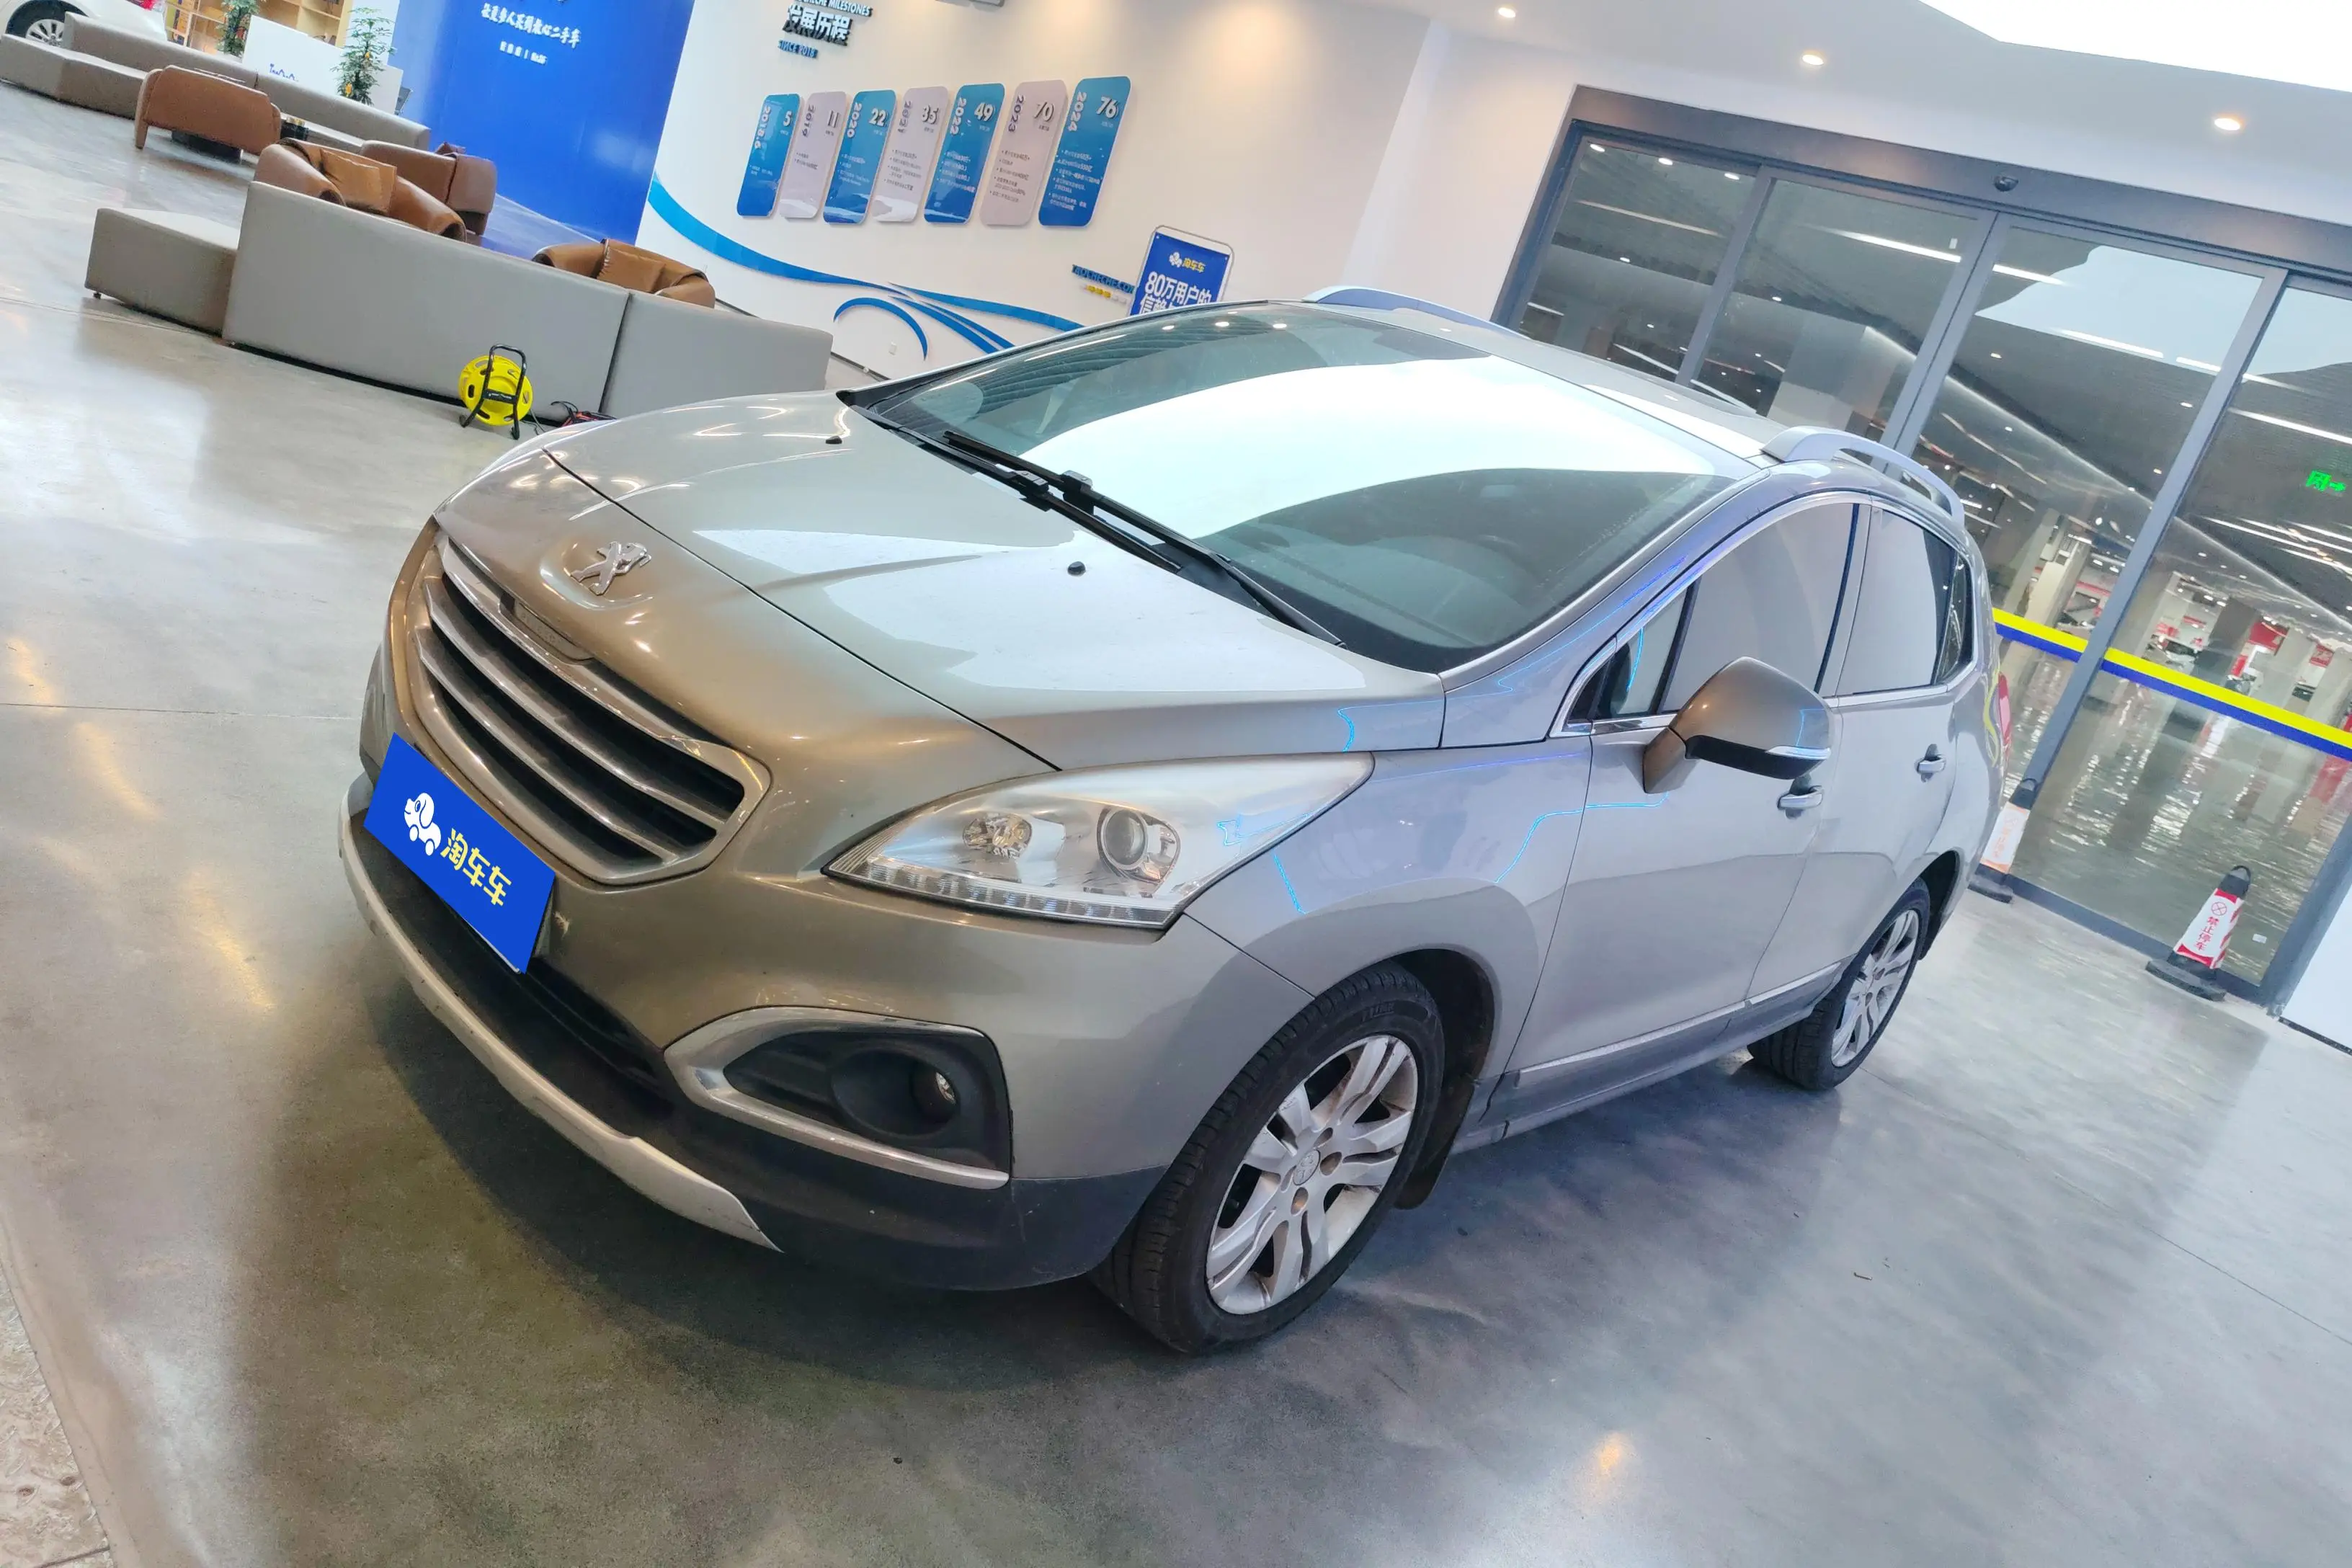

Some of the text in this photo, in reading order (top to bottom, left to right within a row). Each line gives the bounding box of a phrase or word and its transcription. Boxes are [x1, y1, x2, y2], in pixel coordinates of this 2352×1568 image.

[786, 4, 852, 43] 发展历程
[783, 110, 793, 127] 5
[802, 104, 816, 137] 2019
[847, 102, 863, 138] 2020
[868, 107, 888, 127] 22
[922, 104, 940, 125] 35
[950, 97, 967, 135] 2022
[974, 102, 995, 122] 49
[1007, 94, 1026, 133] 2023
[1067, 91, 1087, 132] 2024
[1096, 96, 1118, 119] 76
[1139, 294, 1176, 315] 信赖
[1144, 271, 1212, 305] 80万用户的
